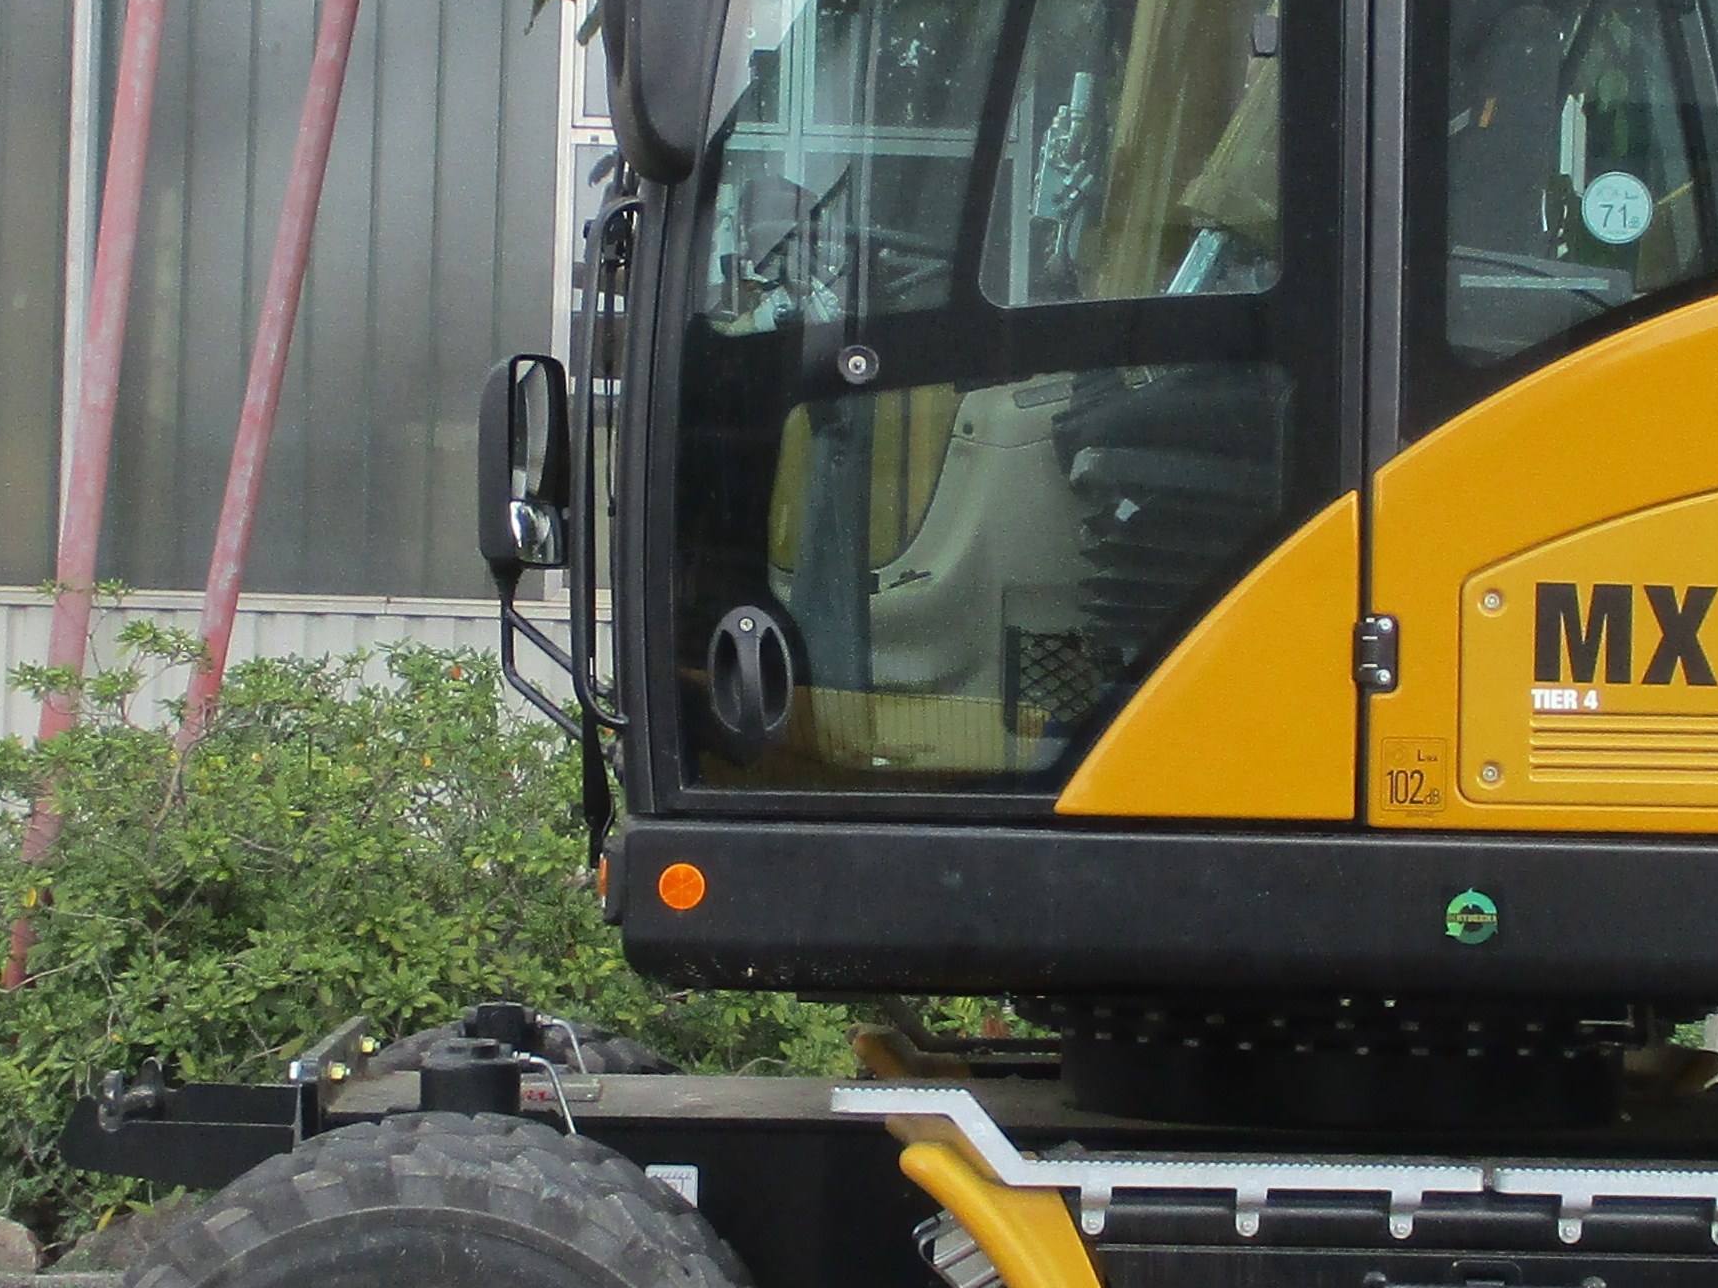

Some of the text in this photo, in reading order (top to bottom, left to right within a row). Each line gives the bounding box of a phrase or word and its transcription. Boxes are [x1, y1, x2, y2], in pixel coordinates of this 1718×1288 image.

[1599, 203, 1627, 229] 71
[1530, 688, 1599, 710] TIER 4
[1386, 769, 1425, 805] 102
